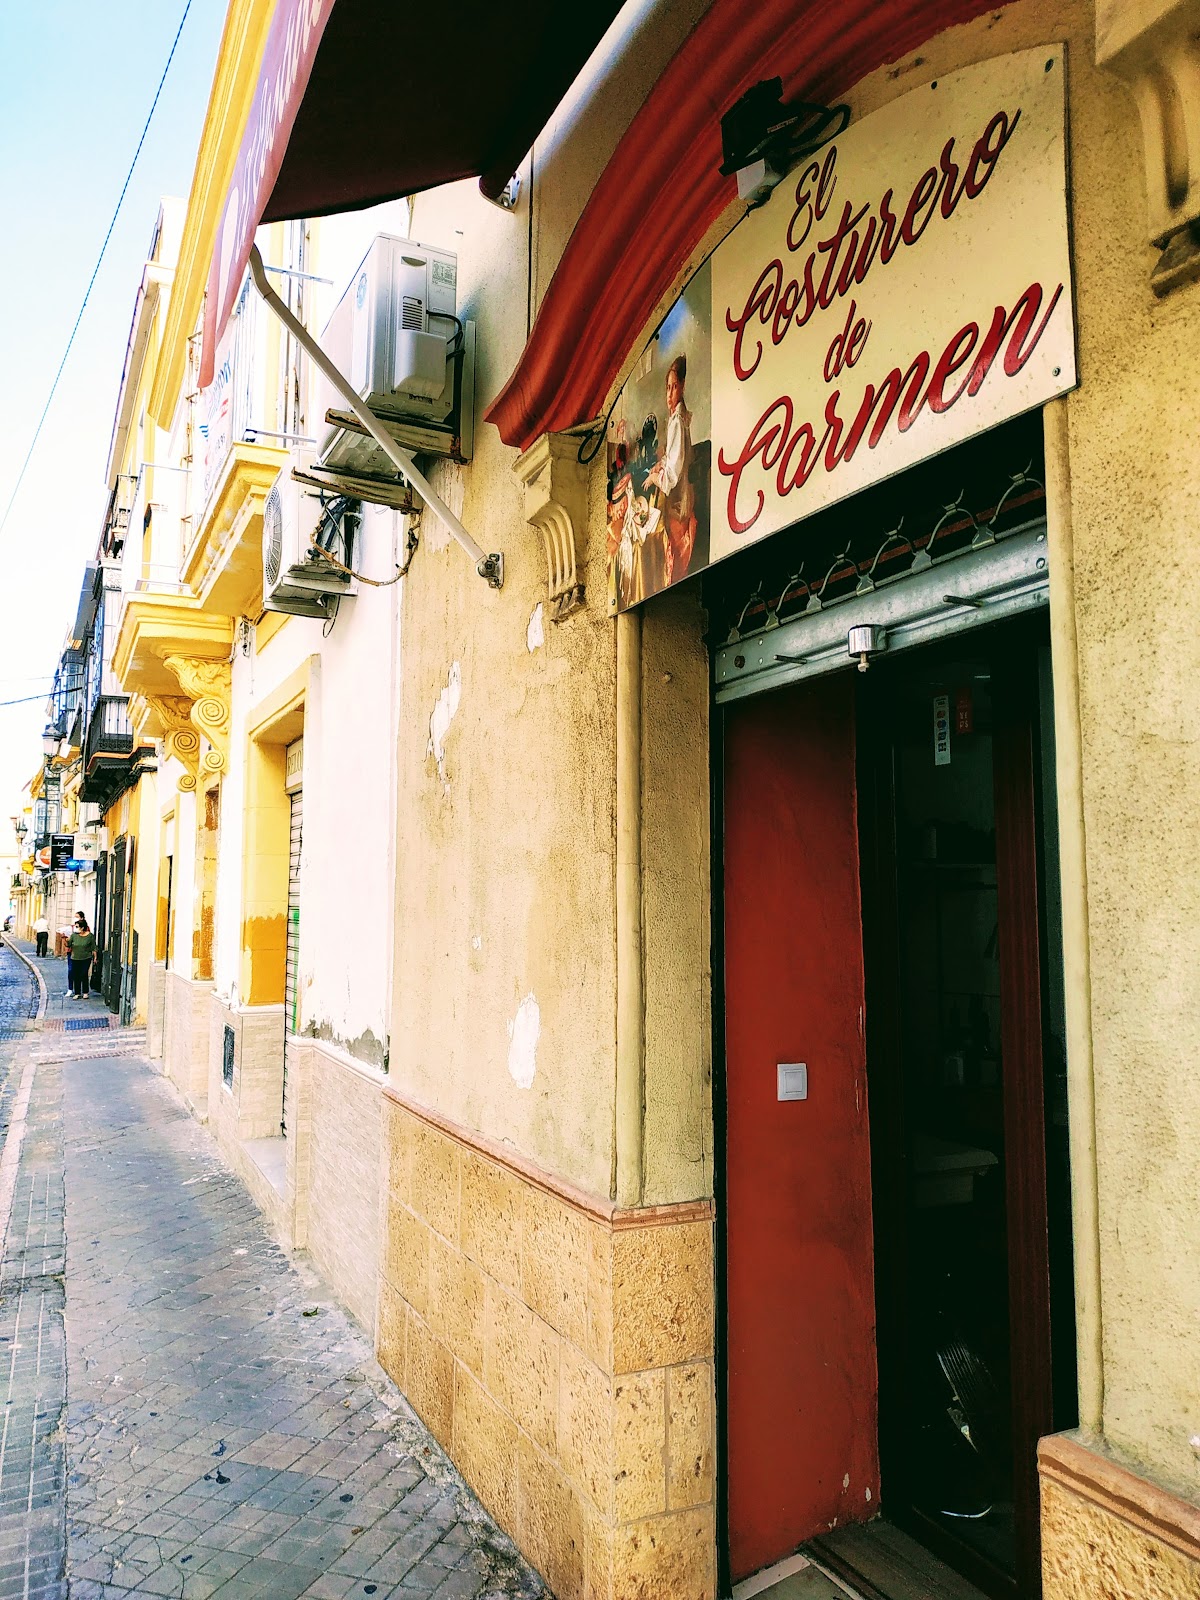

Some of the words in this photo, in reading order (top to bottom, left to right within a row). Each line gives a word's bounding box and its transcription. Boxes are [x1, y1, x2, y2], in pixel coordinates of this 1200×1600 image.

[725, 107, 1022, 382] Costurero
[786, 145, 838, 252] El
[717, 281, 1064, 534] Carmen
[823, 299, 873, 384] de
